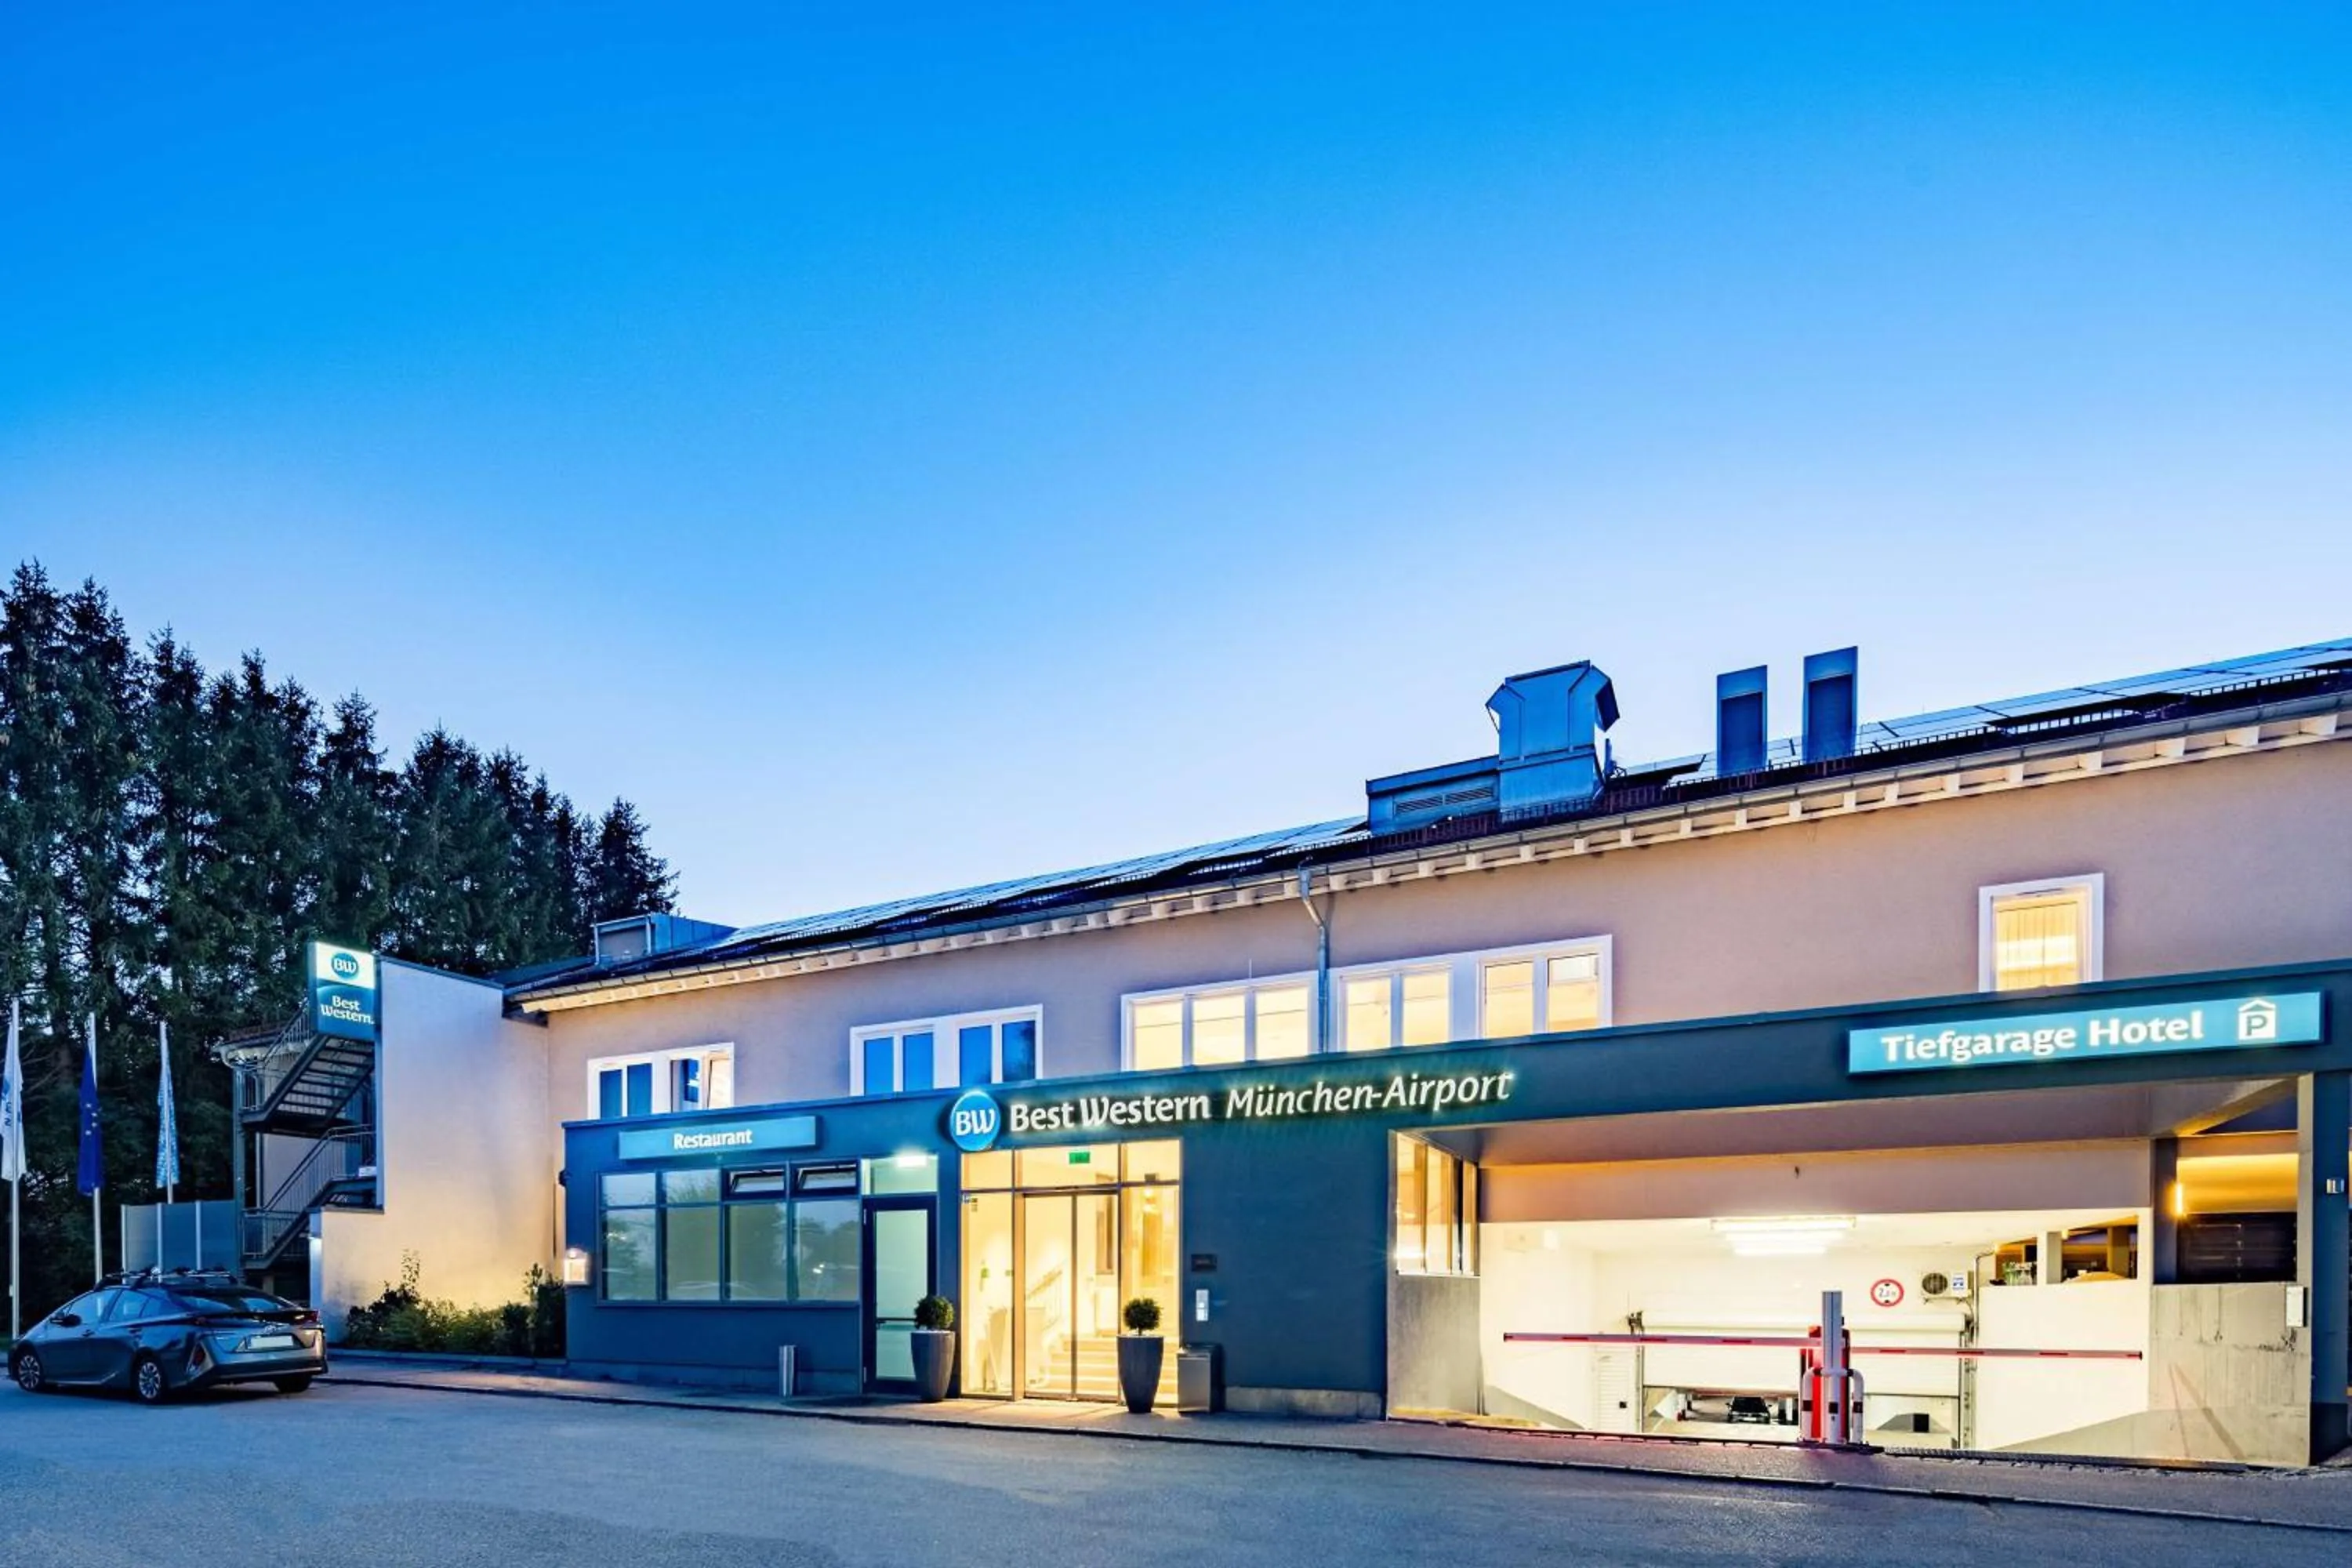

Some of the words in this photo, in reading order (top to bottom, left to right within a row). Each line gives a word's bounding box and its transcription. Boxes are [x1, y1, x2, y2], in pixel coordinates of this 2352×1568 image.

[334, 958, 357, 974] BW
[332, 995, 361, 1011] Best
[1881, 1027, 2077, 1062] Tiefgarage
[2089, 1009, 2204, 1047] Hotel
[2245, 1014, 2268, 1036] P
[1010, 1099, 1075, 1131] Best
[1079, 1094, 1212, 1127] Western
[1225, 1070, 1515, 1119] München-Airport
[955, 1109, 995, 1135] BW
[673, 1128, 753, 1149] Restaurant
